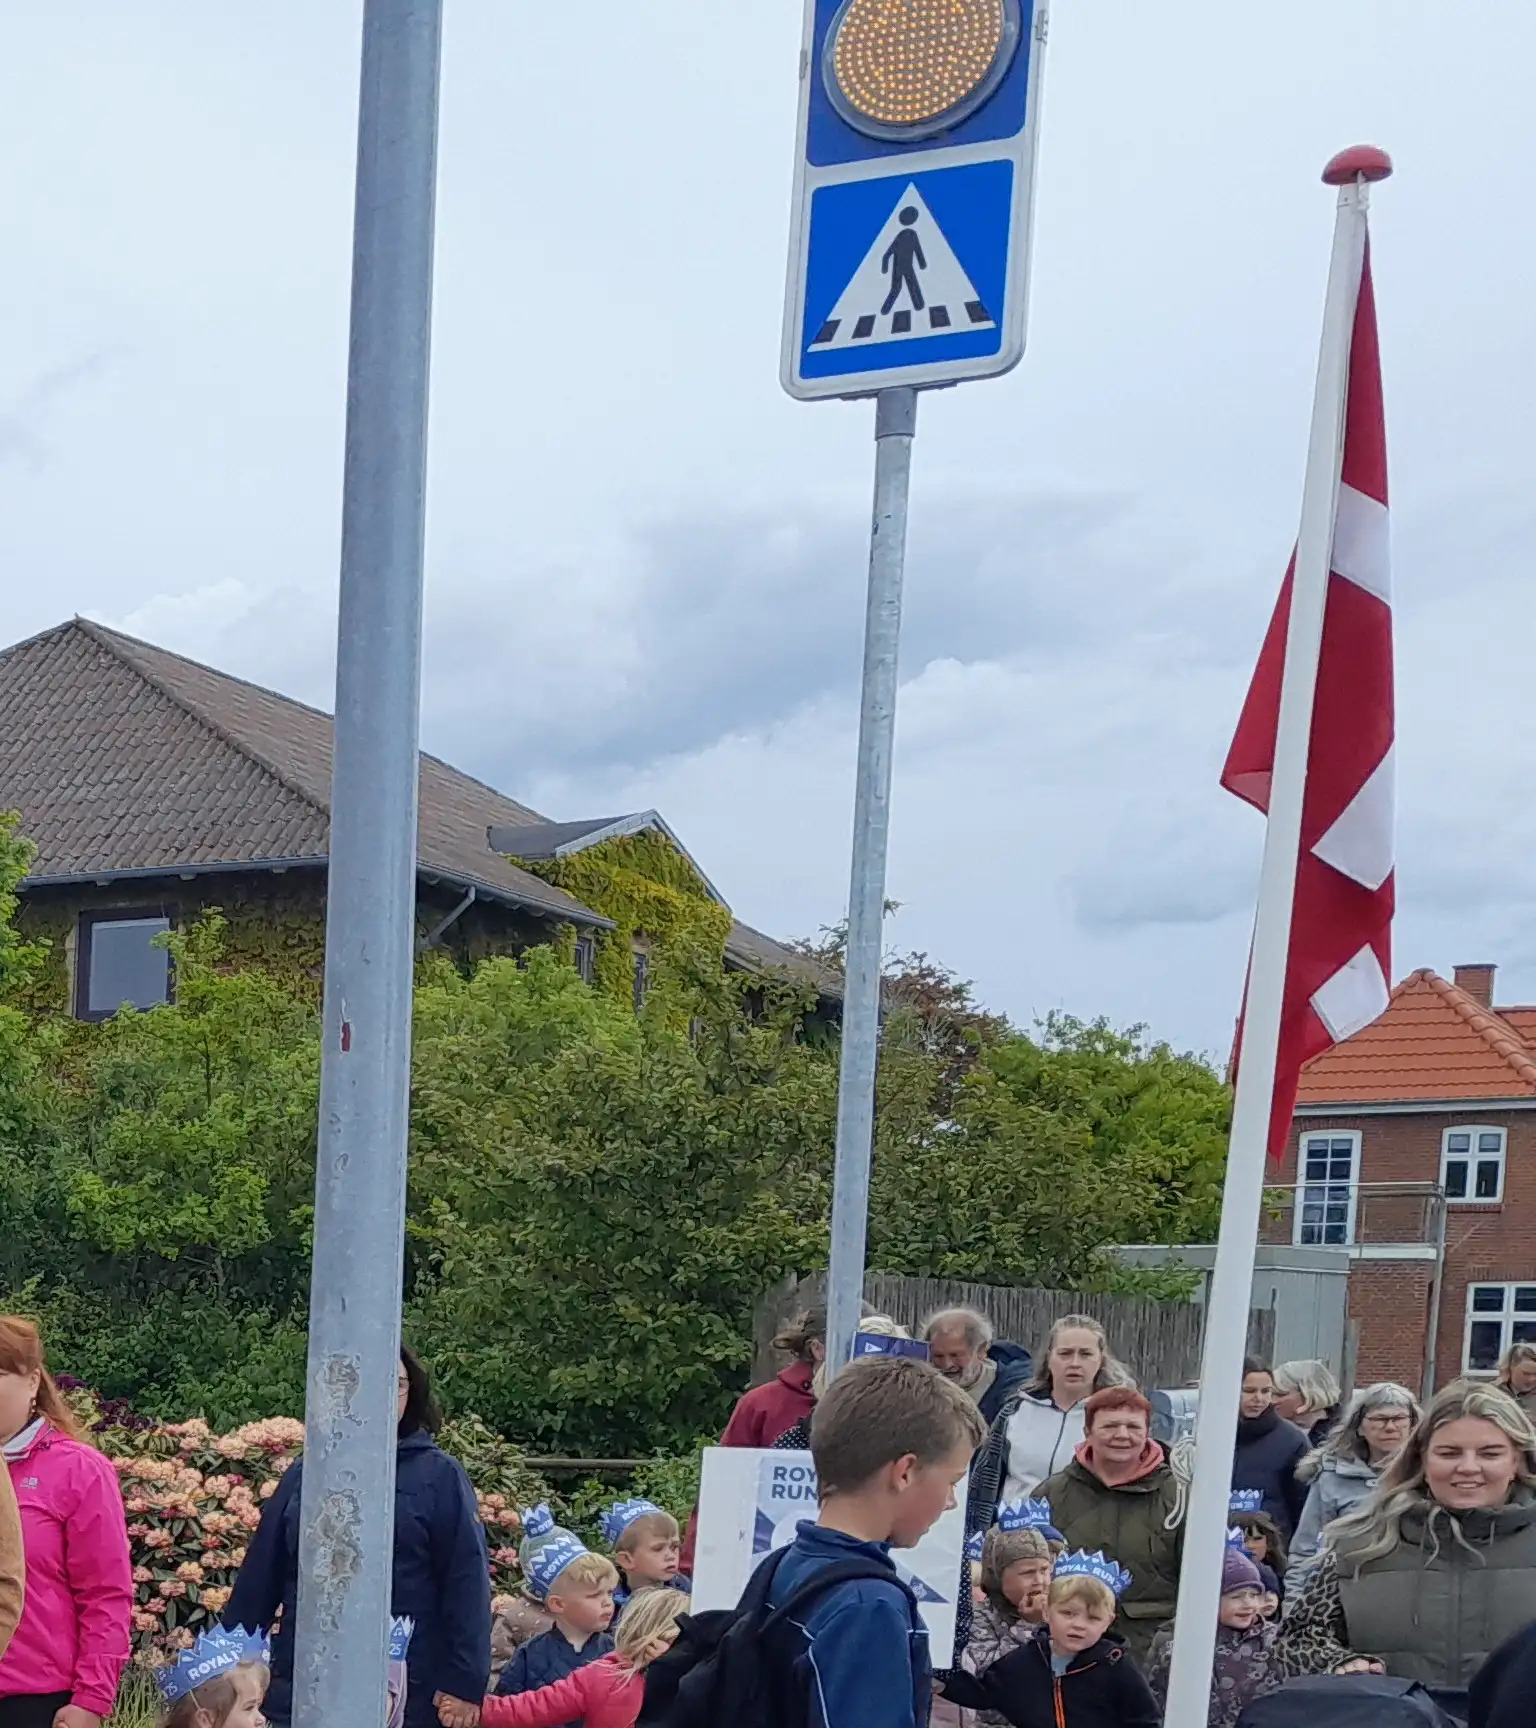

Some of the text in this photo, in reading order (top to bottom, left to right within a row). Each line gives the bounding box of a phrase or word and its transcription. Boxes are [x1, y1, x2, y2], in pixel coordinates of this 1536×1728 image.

[771, 1484, 818, 1501] RUN
[541, 1551, 573, 1580] ROYAL
[1055, 1563, 1089, 1576] ROYAL
[187, 1651, 234, 1681] ROYAL
